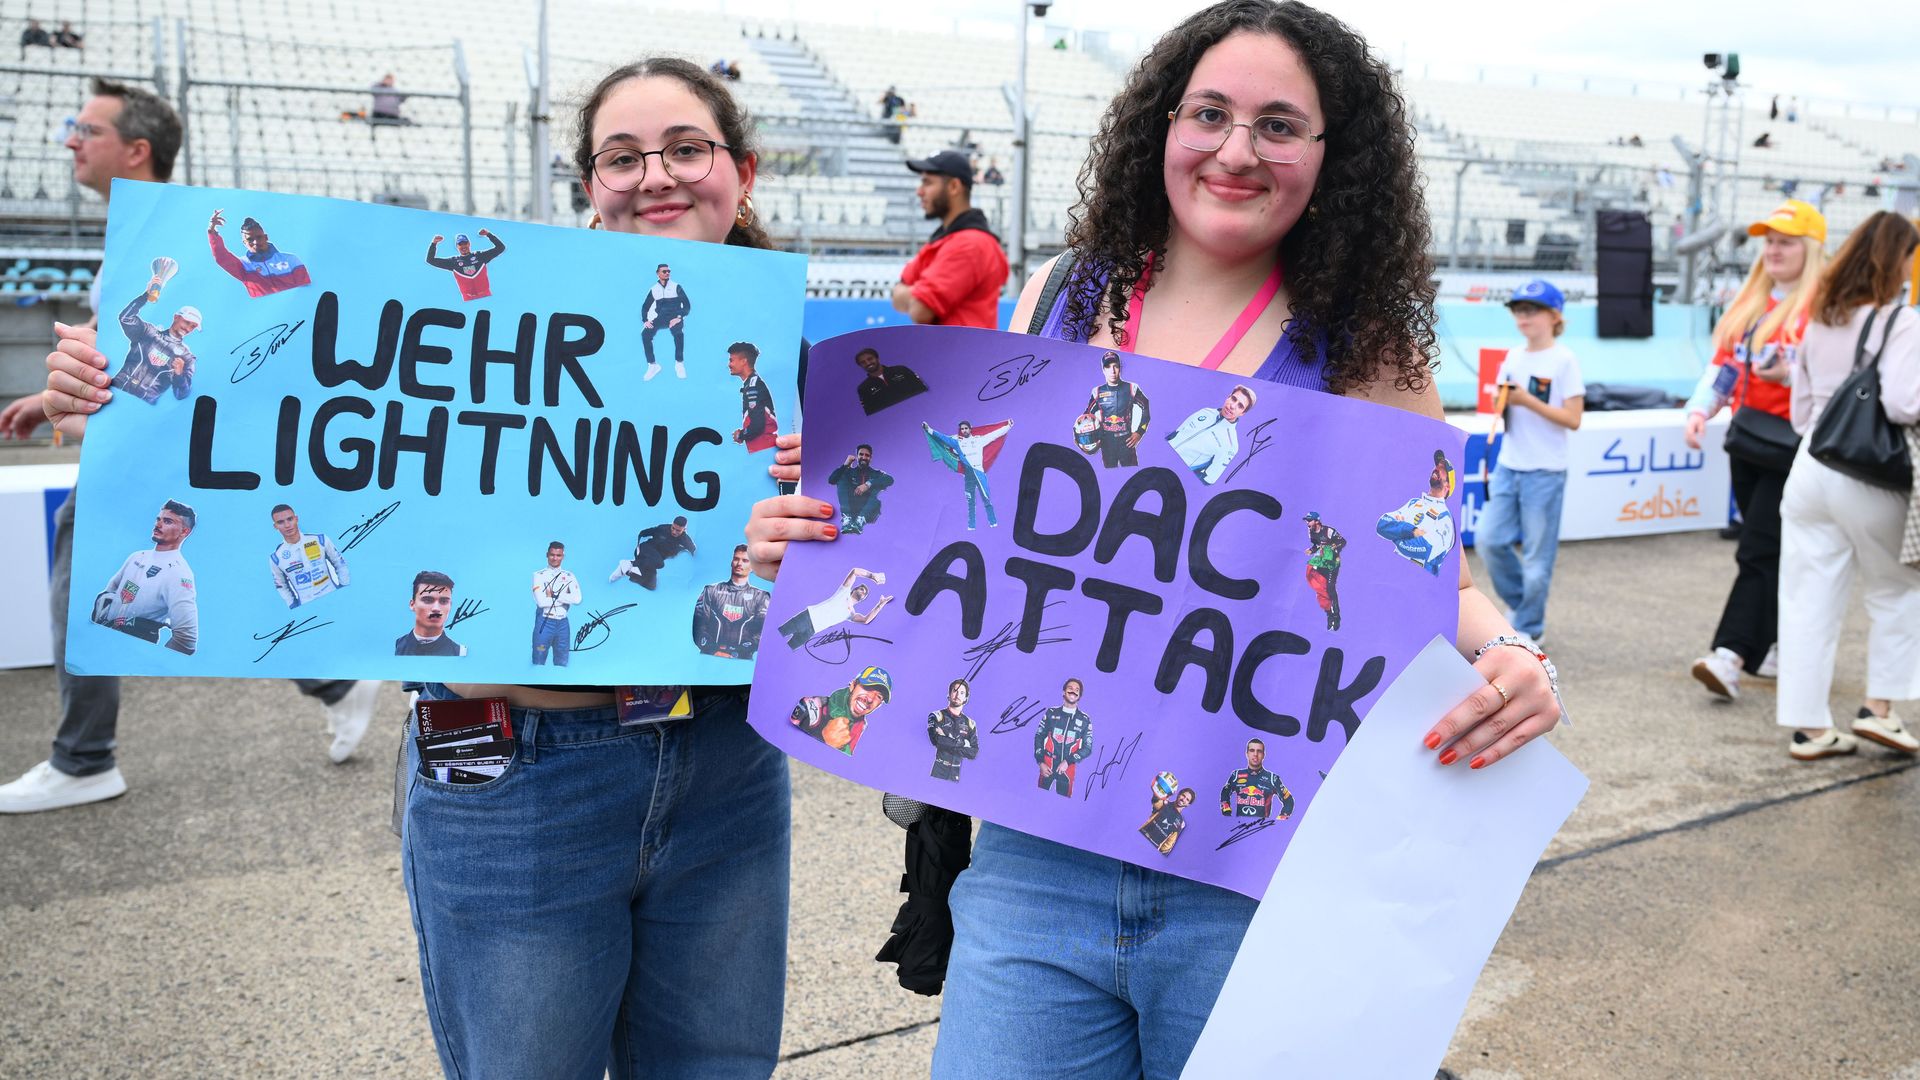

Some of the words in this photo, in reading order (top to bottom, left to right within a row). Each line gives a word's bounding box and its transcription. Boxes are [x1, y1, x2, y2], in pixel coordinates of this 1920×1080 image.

[312, 292, 605, 409] WEHR
[188, 395, 723, 512] LIGHTNING
[1586, 437, 1705, 487] سابك
[1615, 484, 1702, 523] sabic
[1012, 442, 1283, 601] DAC
[904, 540, 1386, 744] ATTACK
[421, 706, 431, 736] ISSAN
